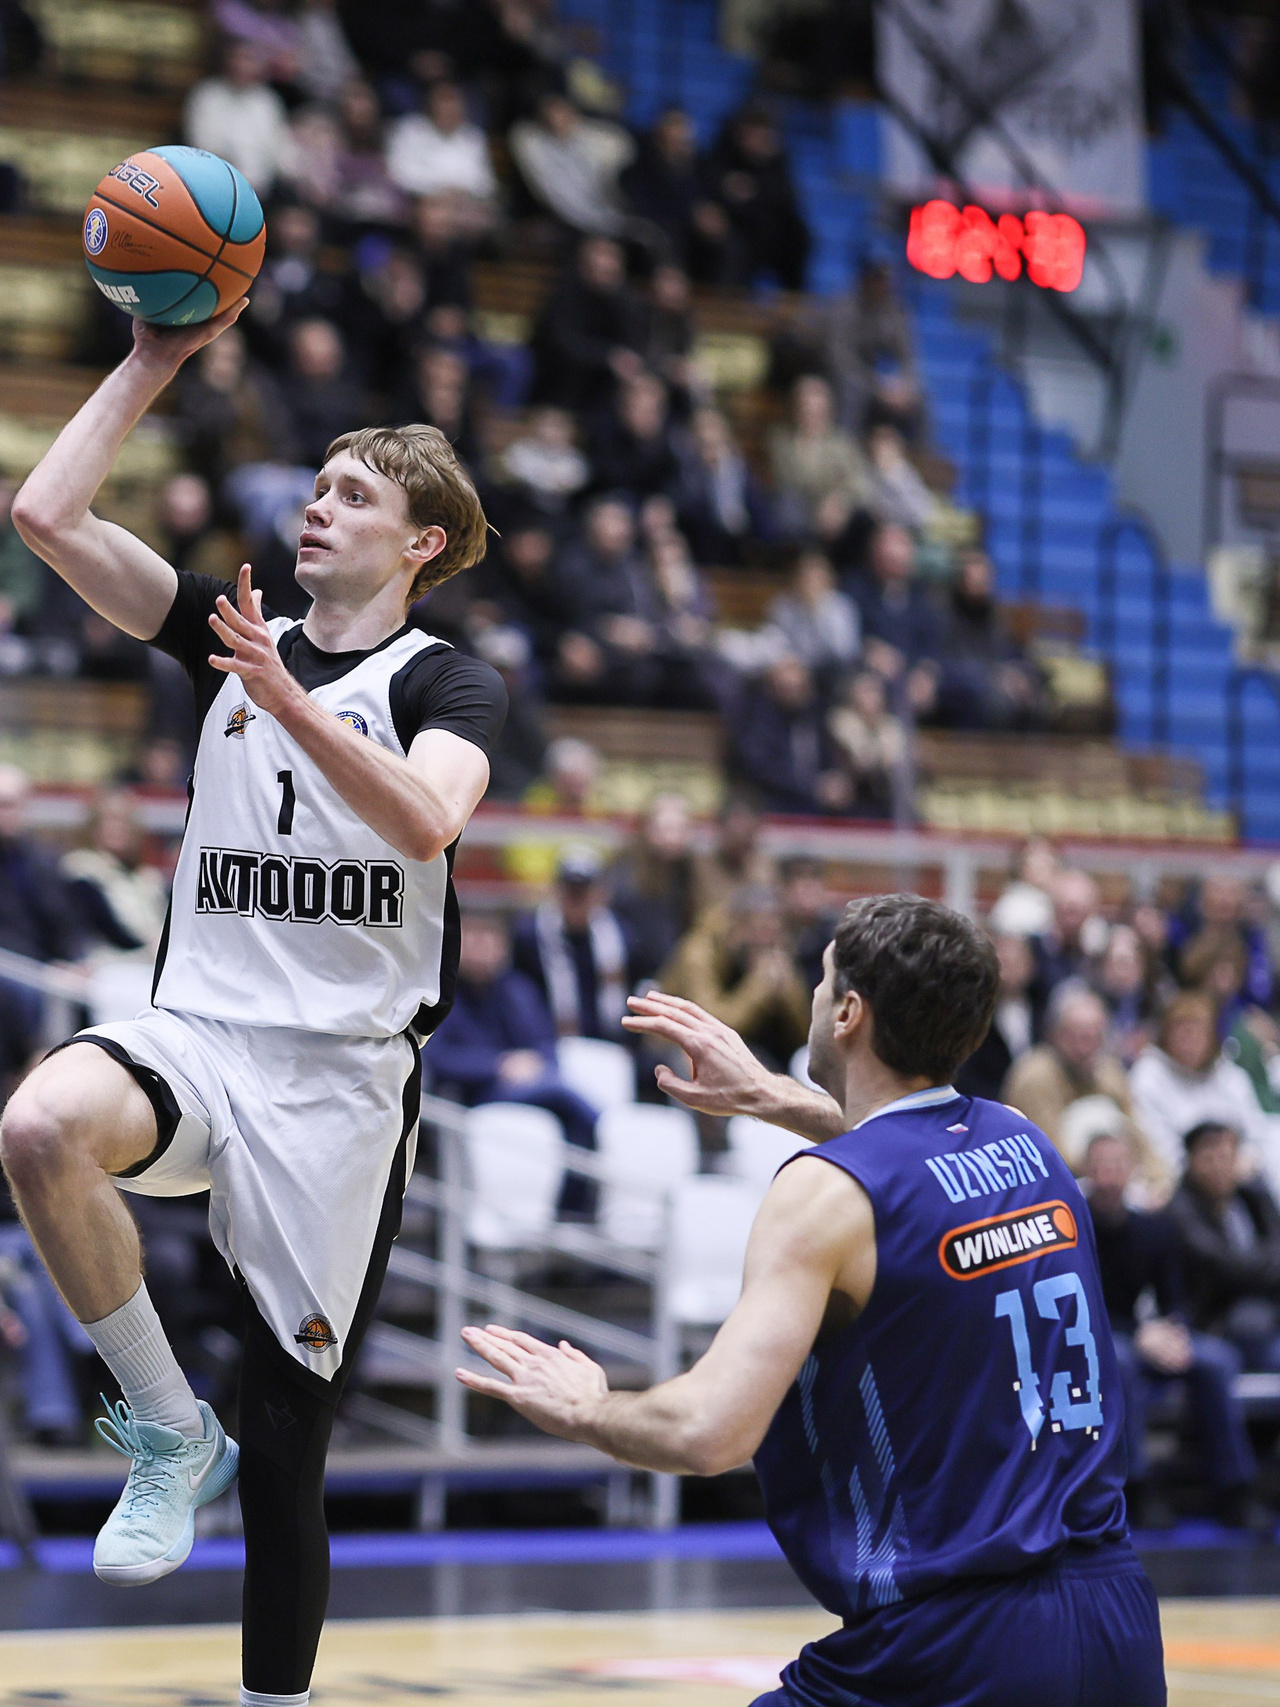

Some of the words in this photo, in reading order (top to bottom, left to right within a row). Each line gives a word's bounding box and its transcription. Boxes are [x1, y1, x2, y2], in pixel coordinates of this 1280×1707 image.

[277, 770, 296, 835] 1
[195, 846, 404, 928] AVTODOR
[925, 1133, 1050, 1204] UZINSKY
[953, 1214, 1058, 1270] WINLINE
[994, 1272, 1105, 1442] 13
